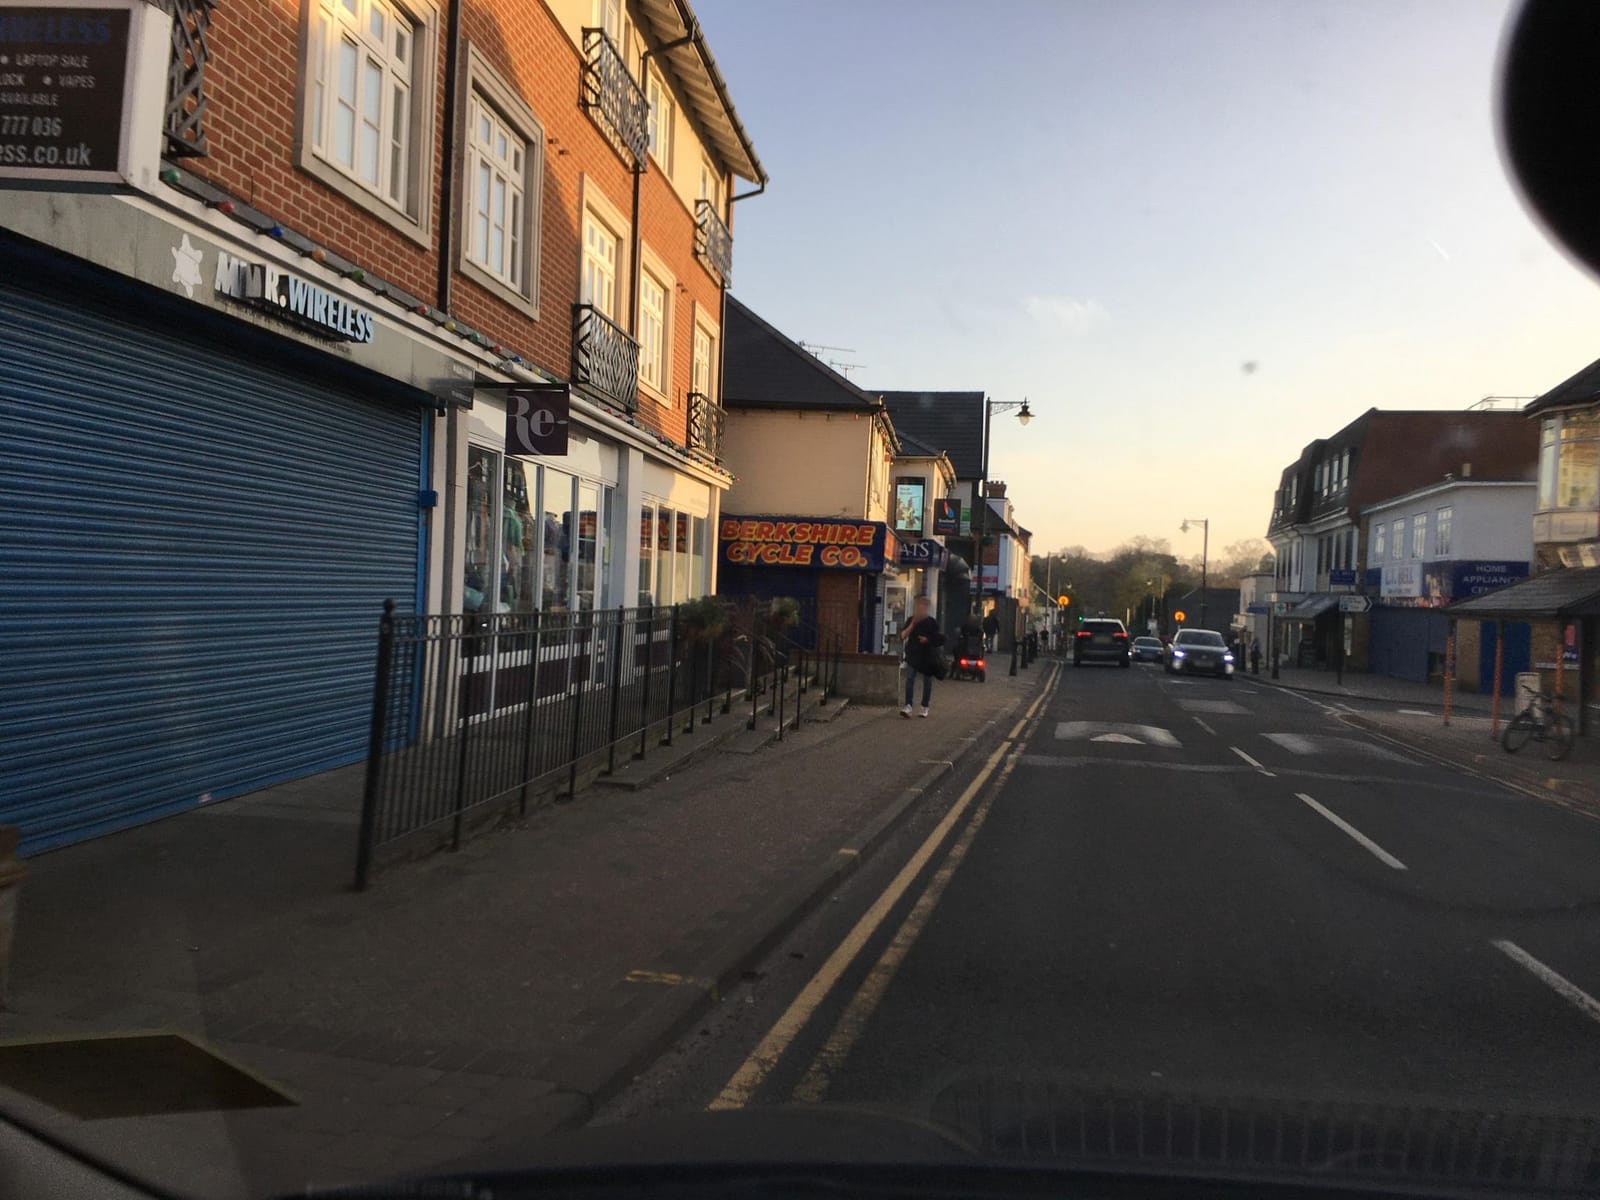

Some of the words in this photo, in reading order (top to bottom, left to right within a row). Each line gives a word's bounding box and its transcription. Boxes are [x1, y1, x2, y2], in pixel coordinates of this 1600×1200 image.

[16, 54, 59, 67] LAPTOP
[60, 55, 88, 69] SALE
[59, 74, 96, 89] VAPES
[2, 115, 28, 135] 777
[32, 116, 61, 136] 036
[289, 273, 374, 344] WIRELESS
[721, 520, 874, 545] BERKSHIRE
[727, 543, 813, 565] CYCLE
[821, 546, 868, 567] CO.
[1475, 565, 1507, 573] HOME
